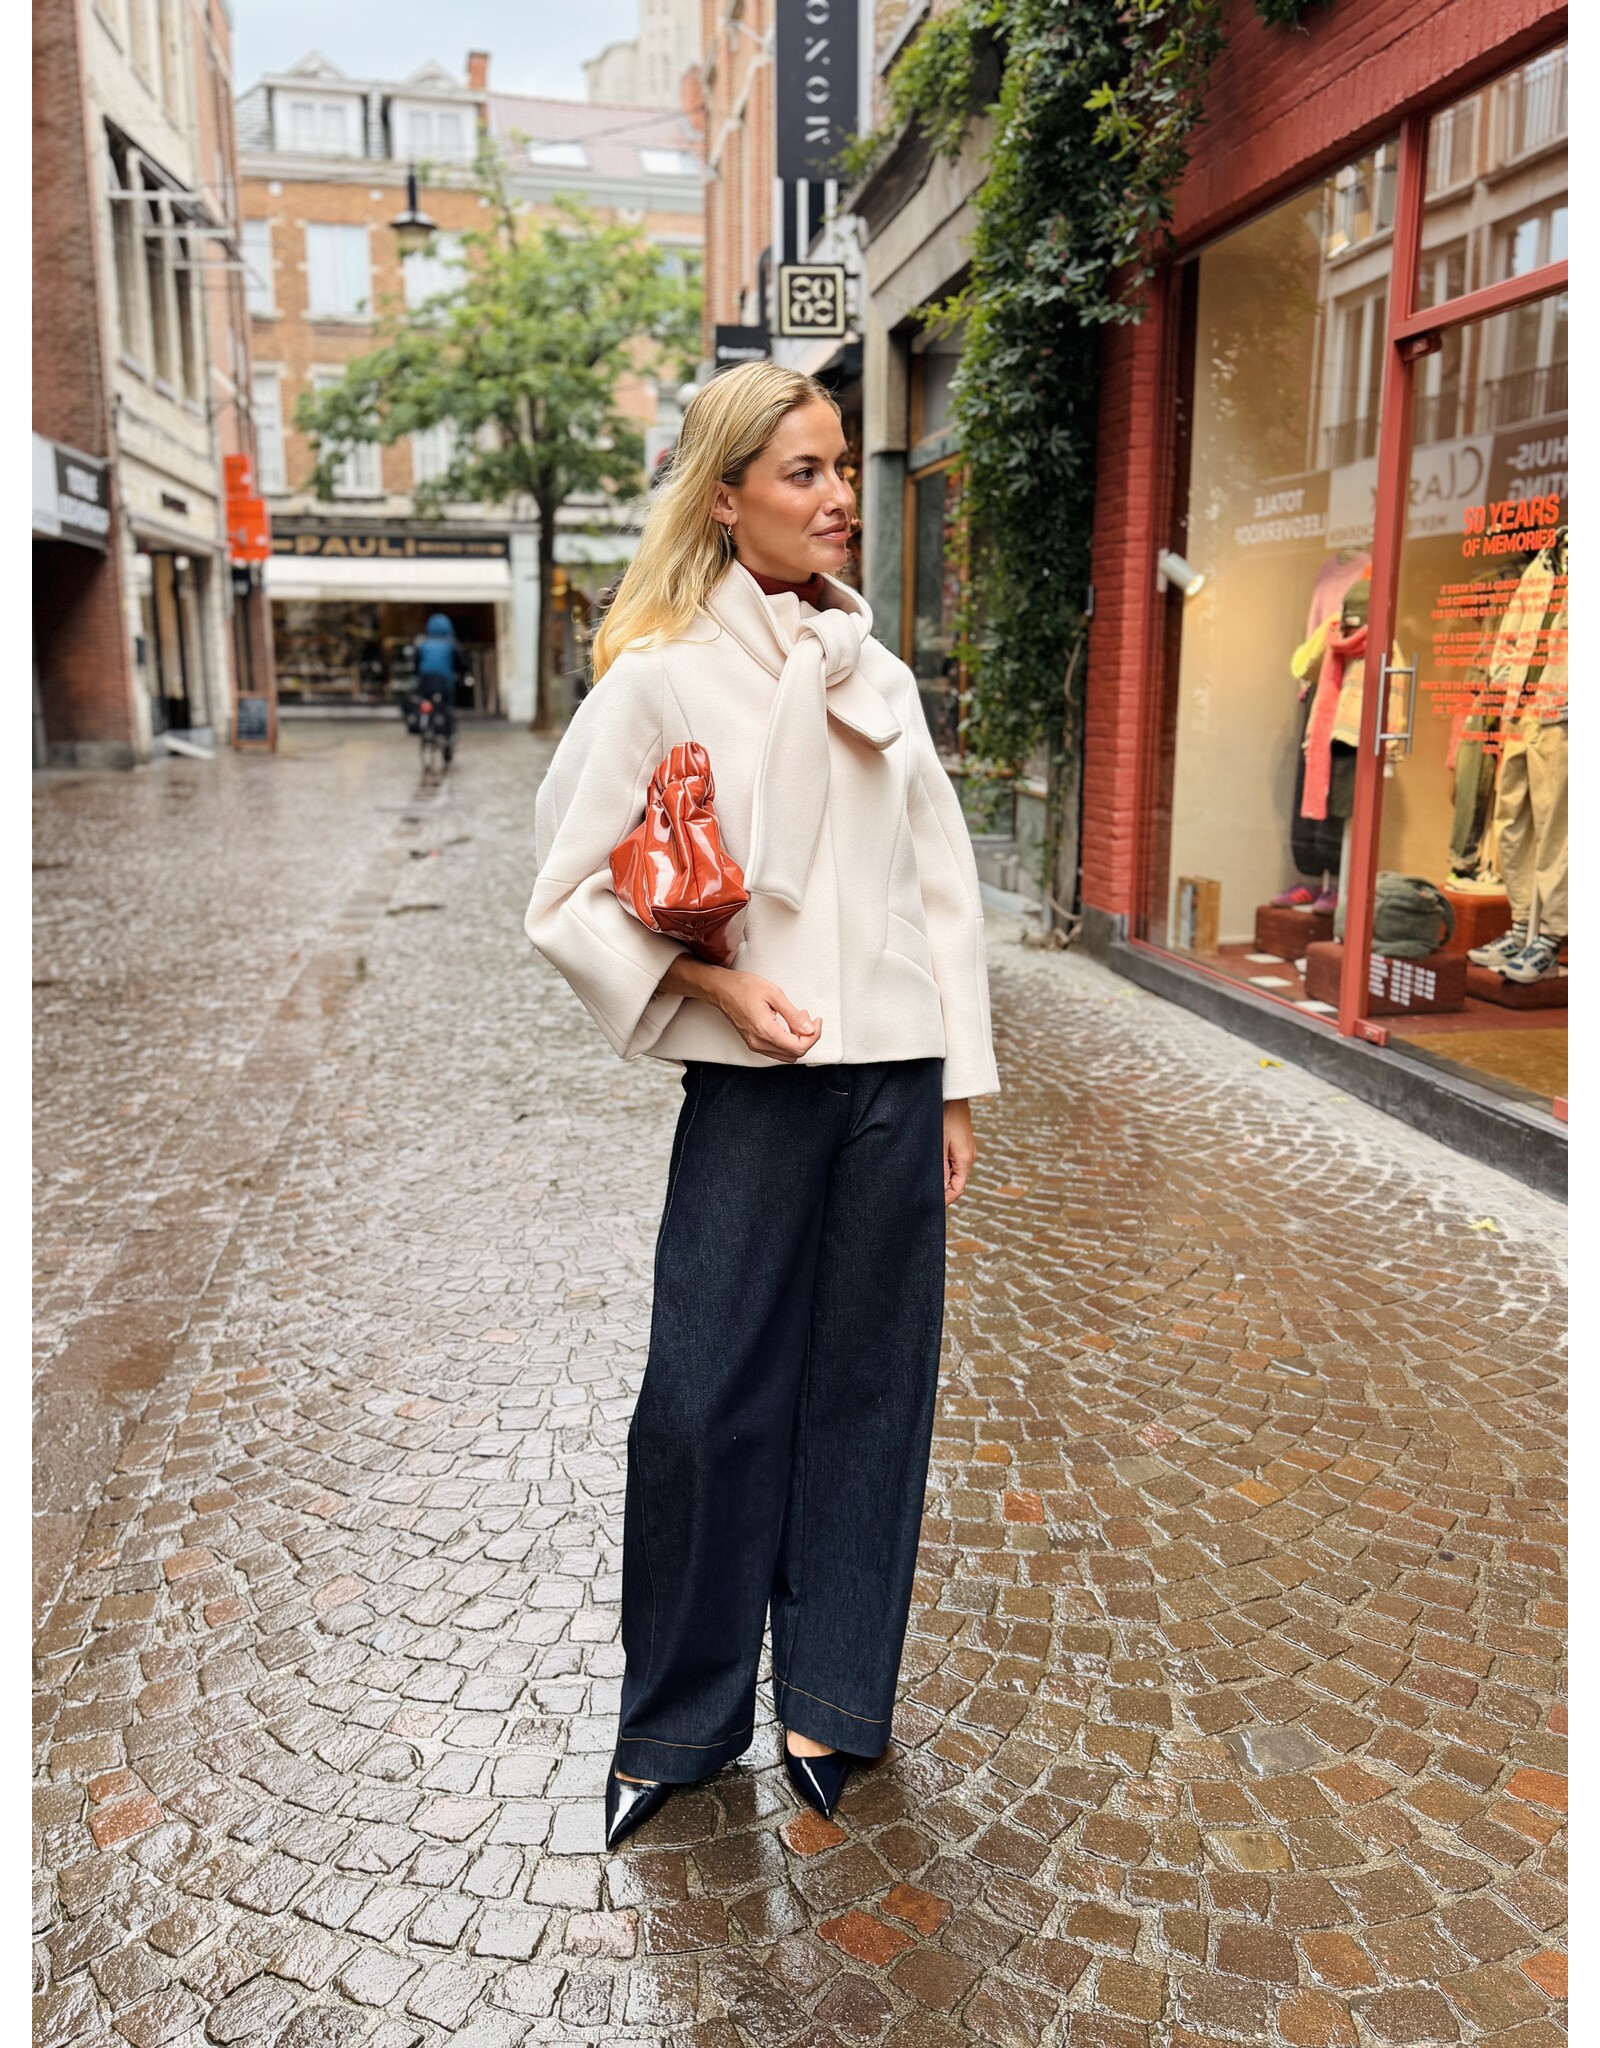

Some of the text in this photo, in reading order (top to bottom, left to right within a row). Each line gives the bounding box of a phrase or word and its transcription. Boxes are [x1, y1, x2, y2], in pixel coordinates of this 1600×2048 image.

[1463, 506, 1486, 536] 50
[1489, 493, 1560, 532] YEARS
[295, 535, 416, 556] PAULI
[1462, 528, 1557, 558] OF MEMORIES
